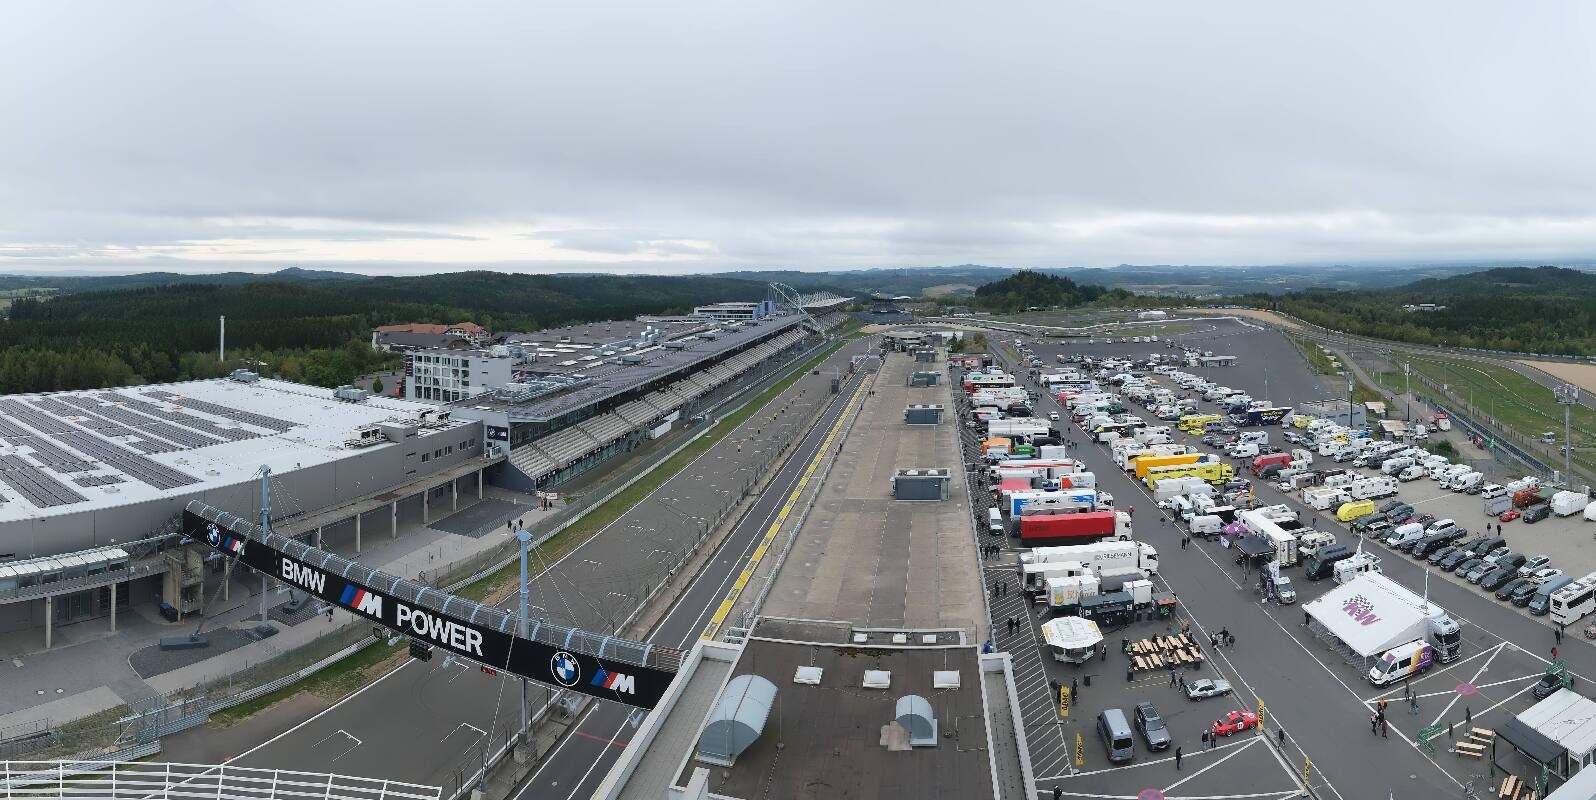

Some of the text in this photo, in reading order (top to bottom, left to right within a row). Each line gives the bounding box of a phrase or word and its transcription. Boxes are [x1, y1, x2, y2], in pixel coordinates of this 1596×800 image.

[282, 558, 484, 657] BMW M POWER
